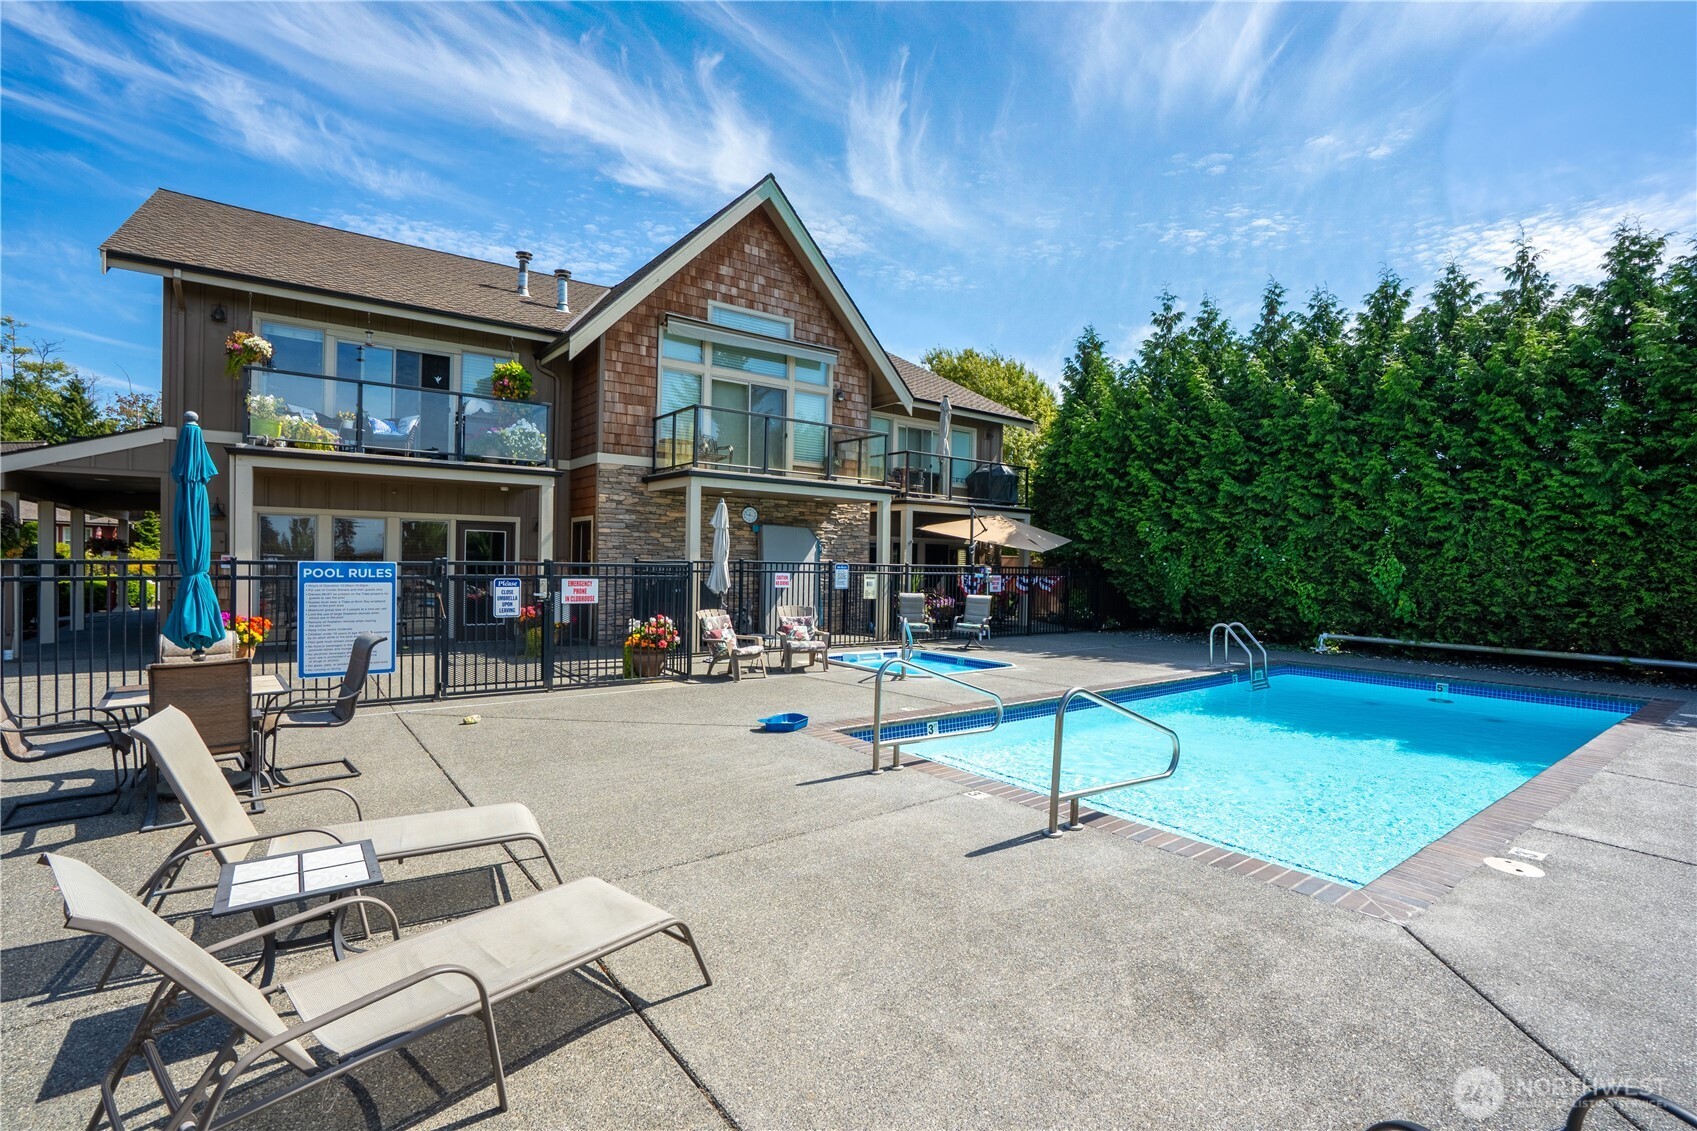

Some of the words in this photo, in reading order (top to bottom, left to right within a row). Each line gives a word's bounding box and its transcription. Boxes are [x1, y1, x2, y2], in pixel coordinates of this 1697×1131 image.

[303, 568, 344, 578] POOL
[348, 568, 393, 578] RULES
[1437, 684, 1444, 693] 5
[928, 724, 934, 735] 3
